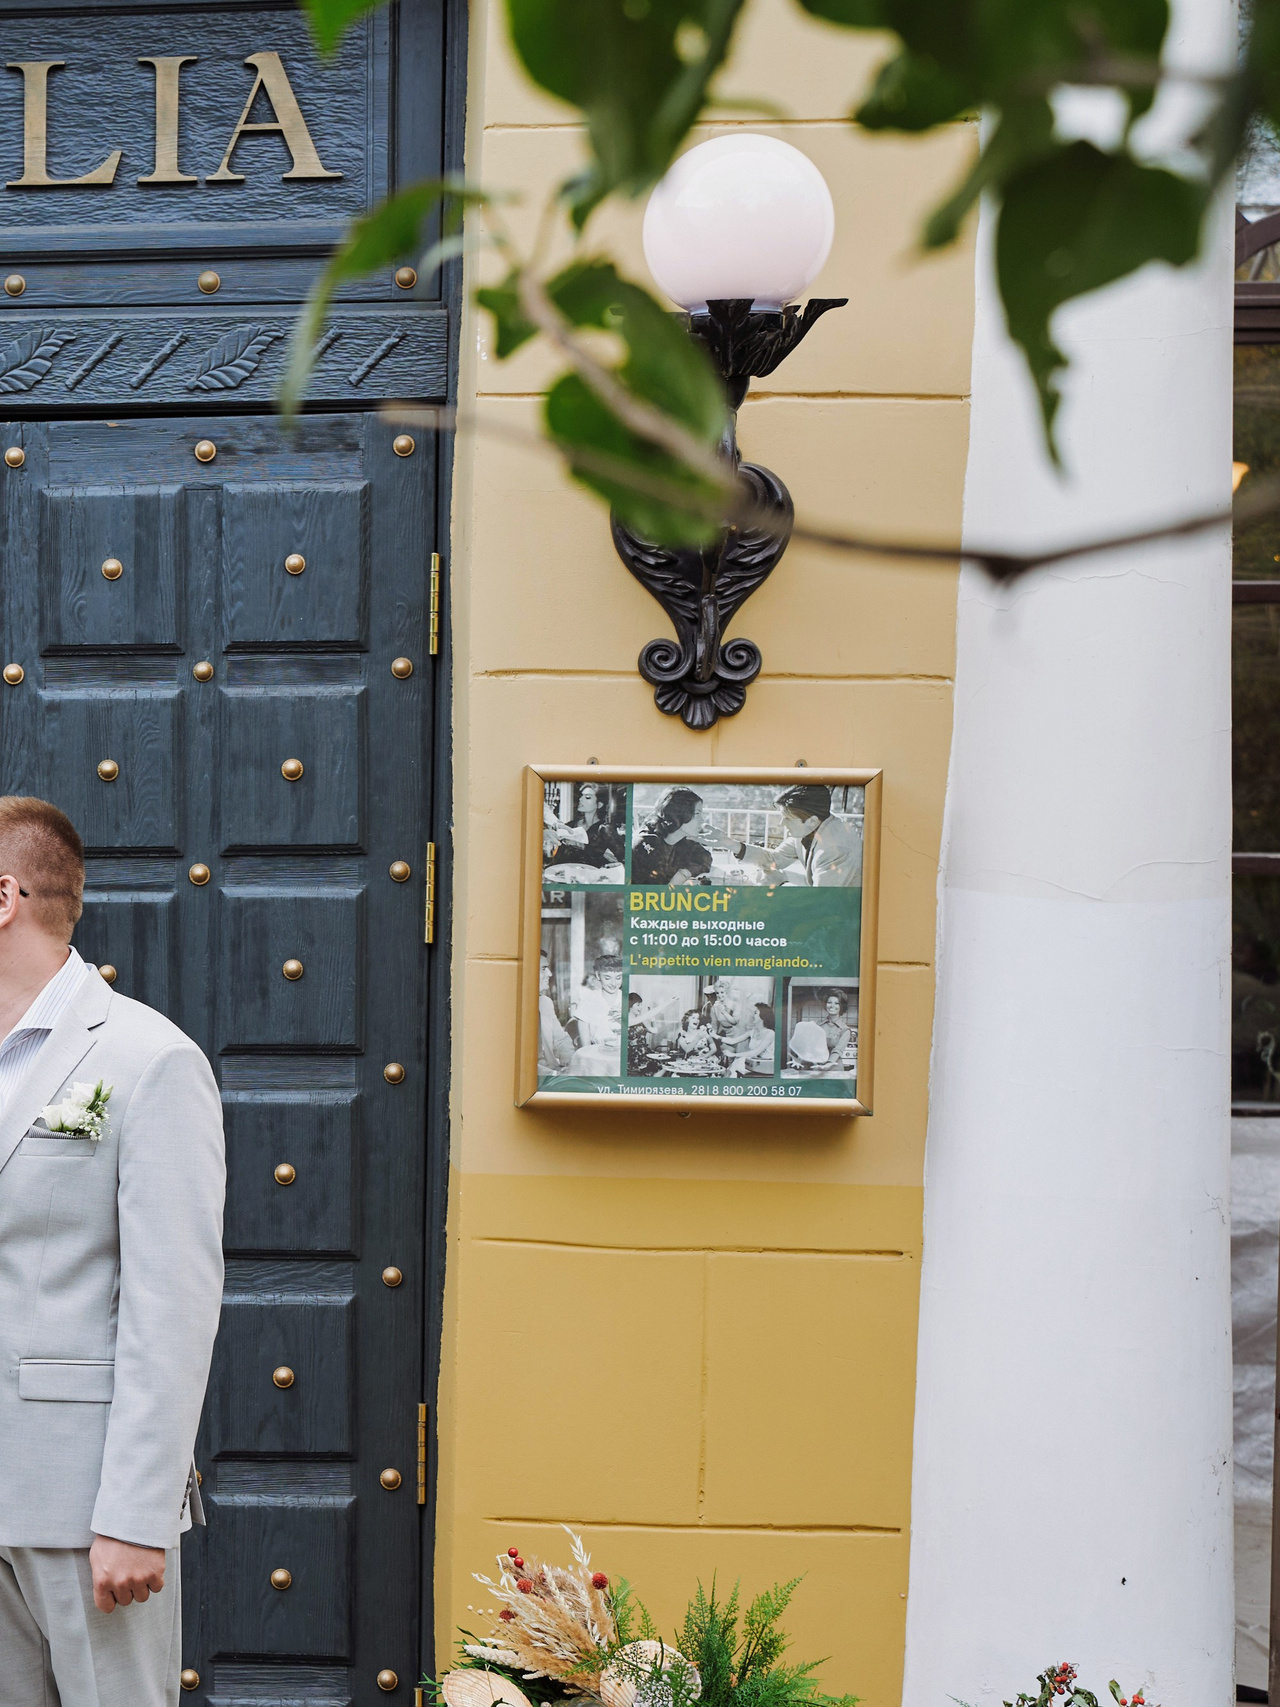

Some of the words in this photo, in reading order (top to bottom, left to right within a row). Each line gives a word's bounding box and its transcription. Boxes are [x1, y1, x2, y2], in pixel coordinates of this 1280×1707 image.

[629, 892, 729, 912] BRUNCH
[630, 917, 689, 931] Каждые
[692, 920, 766, 931] выходные
[629, 936, 639, 945] с
[642, 933, 678, 946] 11:00
[681, 936, 699, 947] до
[703, 934, 742, 947] 15:00
[745, 937, 788, 947] часов
[629, 954, 700, 968] L'appetito
[703, 955, 731, 967] vien
[597, 1086, 614, 1094] ул.
[616, 1084, 687, 1095] Тимирязева,
[722, 1085, 744, 1096] 800
[747, 1086, 768, 1096] 200
[771, 1086, 785, 1096] 58
[788, 1086, 802, 1096] 07
